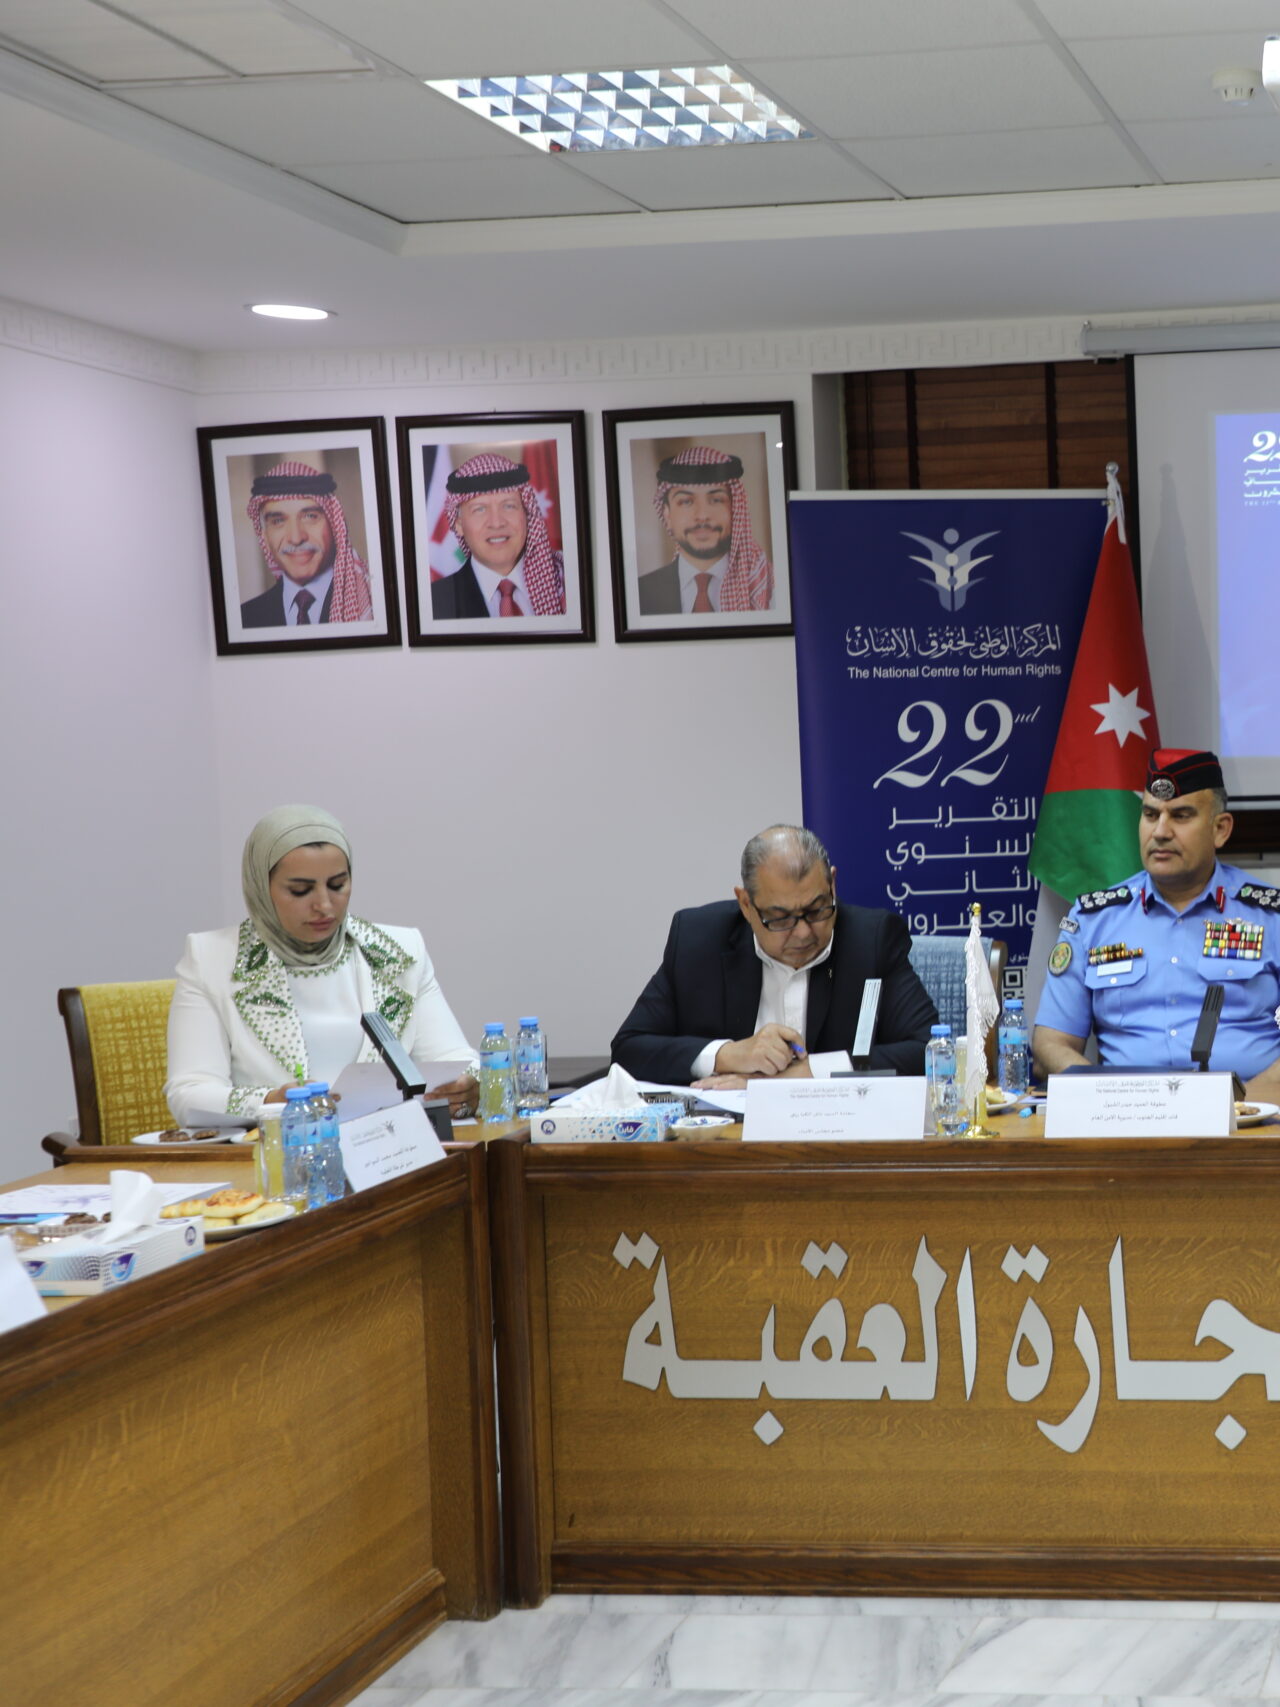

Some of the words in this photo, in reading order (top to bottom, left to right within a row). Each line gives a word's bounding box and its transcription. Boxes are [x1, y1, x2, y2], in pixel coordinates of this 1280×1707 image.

[848, 667, 870, 679] The
[873, 666, 919, 678] National
[921, 665, 960, 677] Centre
[963, 665, 978, 677] for
[981, 664, 1022, 676] Human
[1025, 663, 1062, 678] Rights
[888, 796, 1036, 830] التقرير
[886, 833, 1035, 871] لسنوي
[612, 1231, 978, 1446] العقبة
